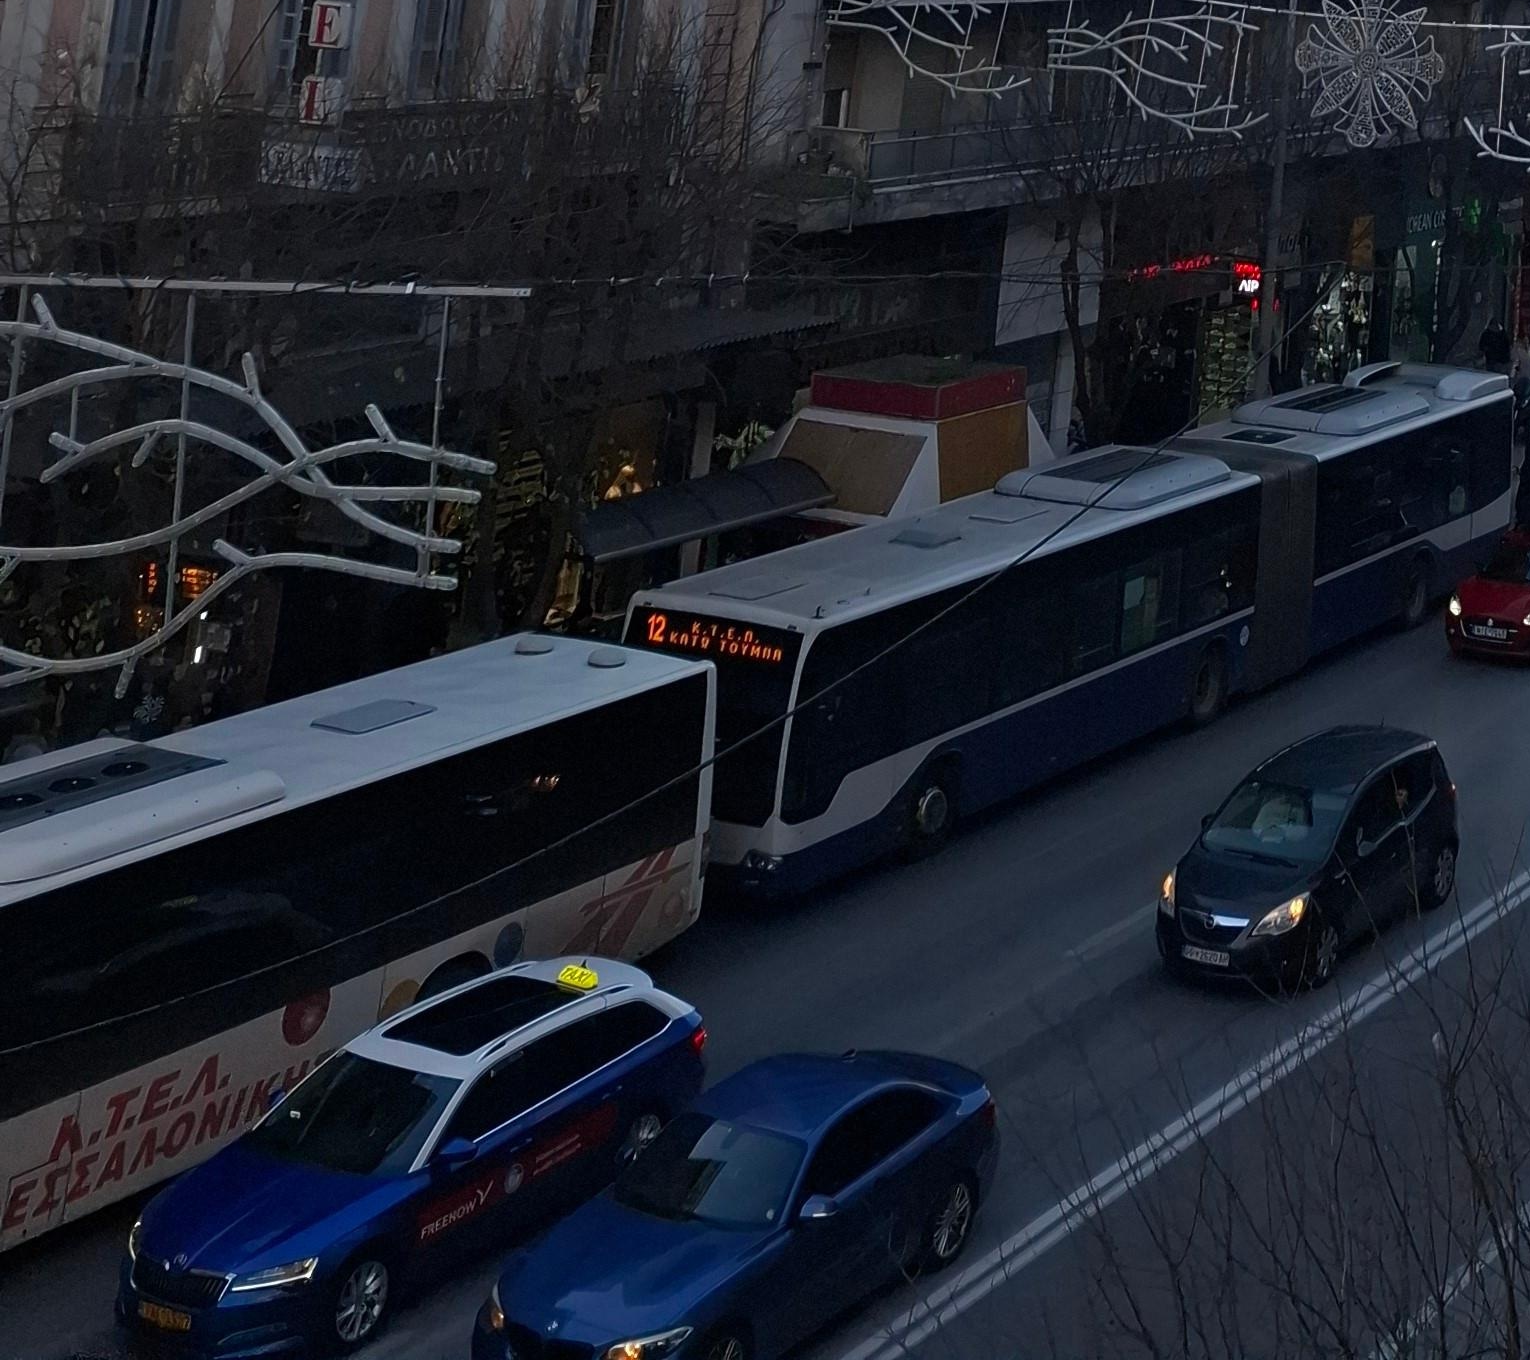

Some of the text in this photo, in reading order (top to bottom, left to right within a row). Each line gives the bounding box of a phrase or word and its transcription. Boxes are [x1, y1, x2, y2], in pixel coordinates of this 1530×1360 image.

[647, 612, 667, 642] 12
[560, 967, 593, 985] TAXI
[0, 1048, 330, 1231] ΕΣΣΑΛΟΝΙΚΗ
